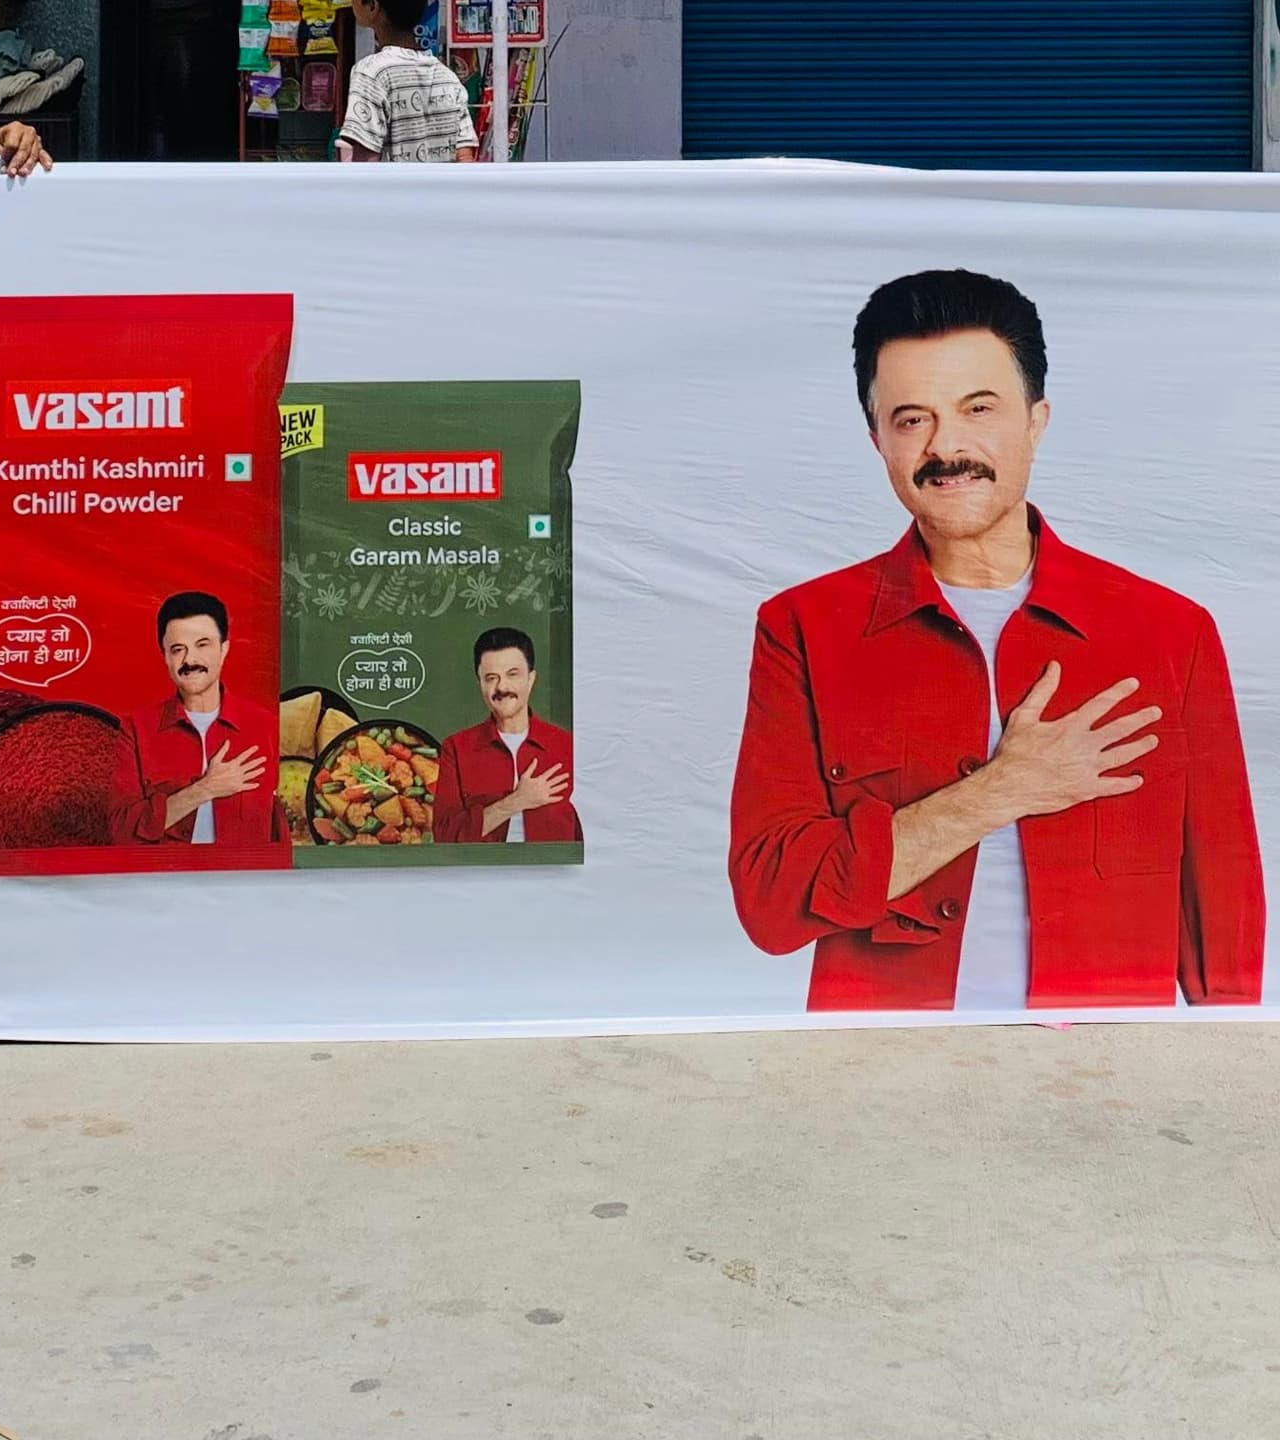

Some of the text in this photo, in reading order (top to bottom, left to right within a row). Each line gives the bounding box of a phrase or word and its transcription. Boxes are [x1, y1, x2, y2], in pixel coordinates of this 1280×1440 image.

[91, 454, 205, 480] Kashmiri
[12, 490, 184, 516] Chilli Powder
[388, 515, 462, 538] Classic
[349, 545, 501, 568] Garam Masala
[0, 594, 77, 611] क्वालिटी ऐसी
[6, 623, 71, 644] प्यार तो
[349, 631, 414, 647] क्वालिटी ऐसी
[32, 645, 50, 666] ही
[53, 649, 81, 665] था!
[354, 656, 409, 676] प्यार तो
[345, 673, 418, 693] होना ही था!
